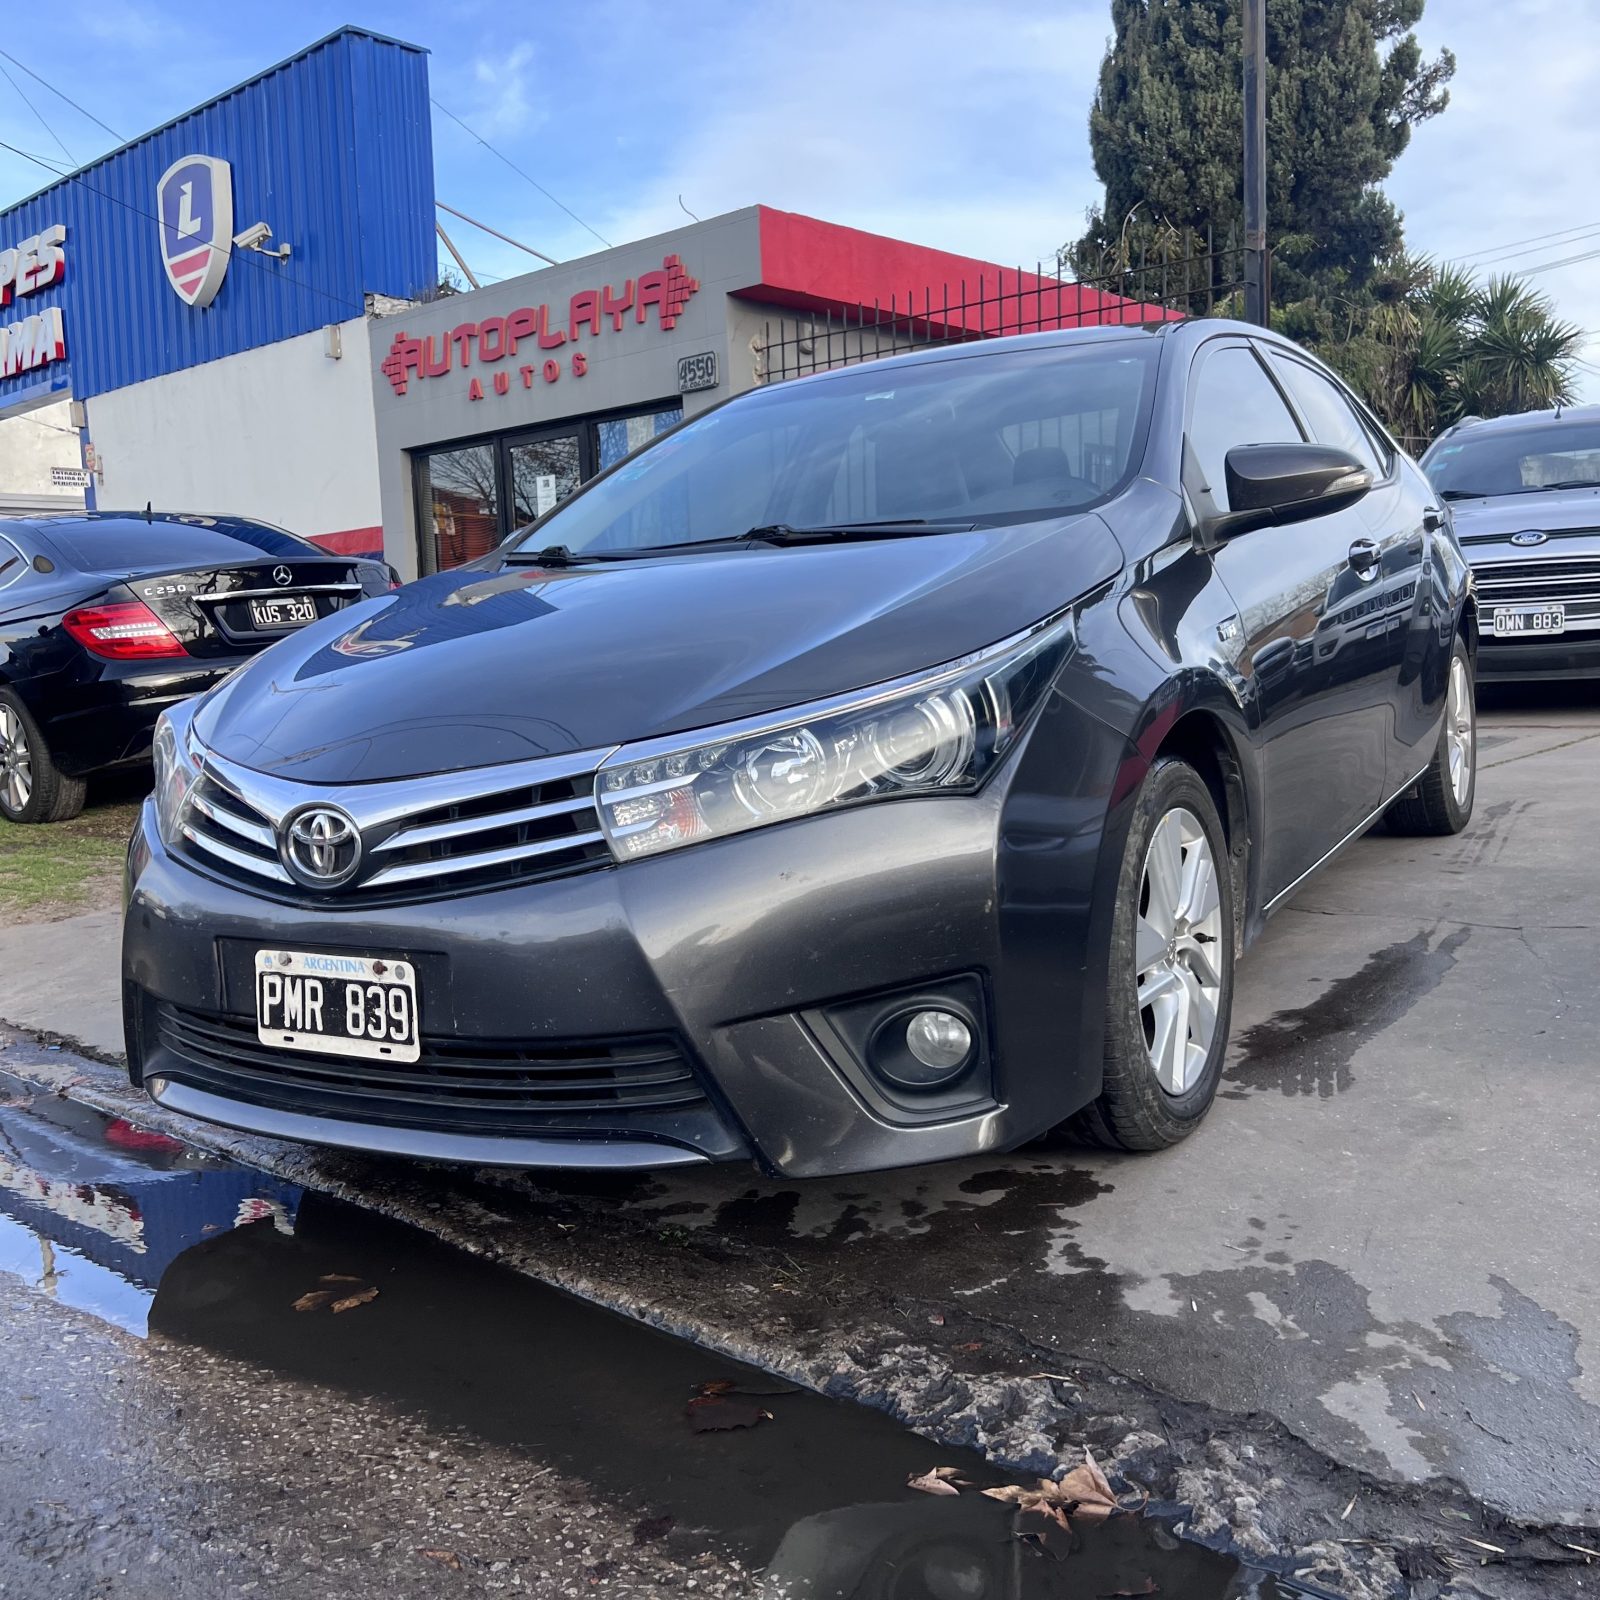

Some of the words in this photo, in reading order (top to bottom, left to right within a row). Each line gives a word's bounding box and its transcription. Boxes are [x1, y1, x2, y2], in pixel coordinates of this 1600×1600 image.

[398, 269, 672, 379] AUTOPLAYA
[468, 352, 588, 401] AUTOS
[680, 355, 714, 384] 4550
[144, 588, 153, 596] C
[156, 584, 187, 595] 250
[253, 605, 281, 624] KUS
[287, 603, 315, 621] 320
[1496, 614, 1524, 631] OWN
[1533, 612, 1561, 629] 883
[303, 956, 366, 974] ARGENTINA
[263, 974, 324, 1032] PMR
[345, 983, 409, 1041] 839
